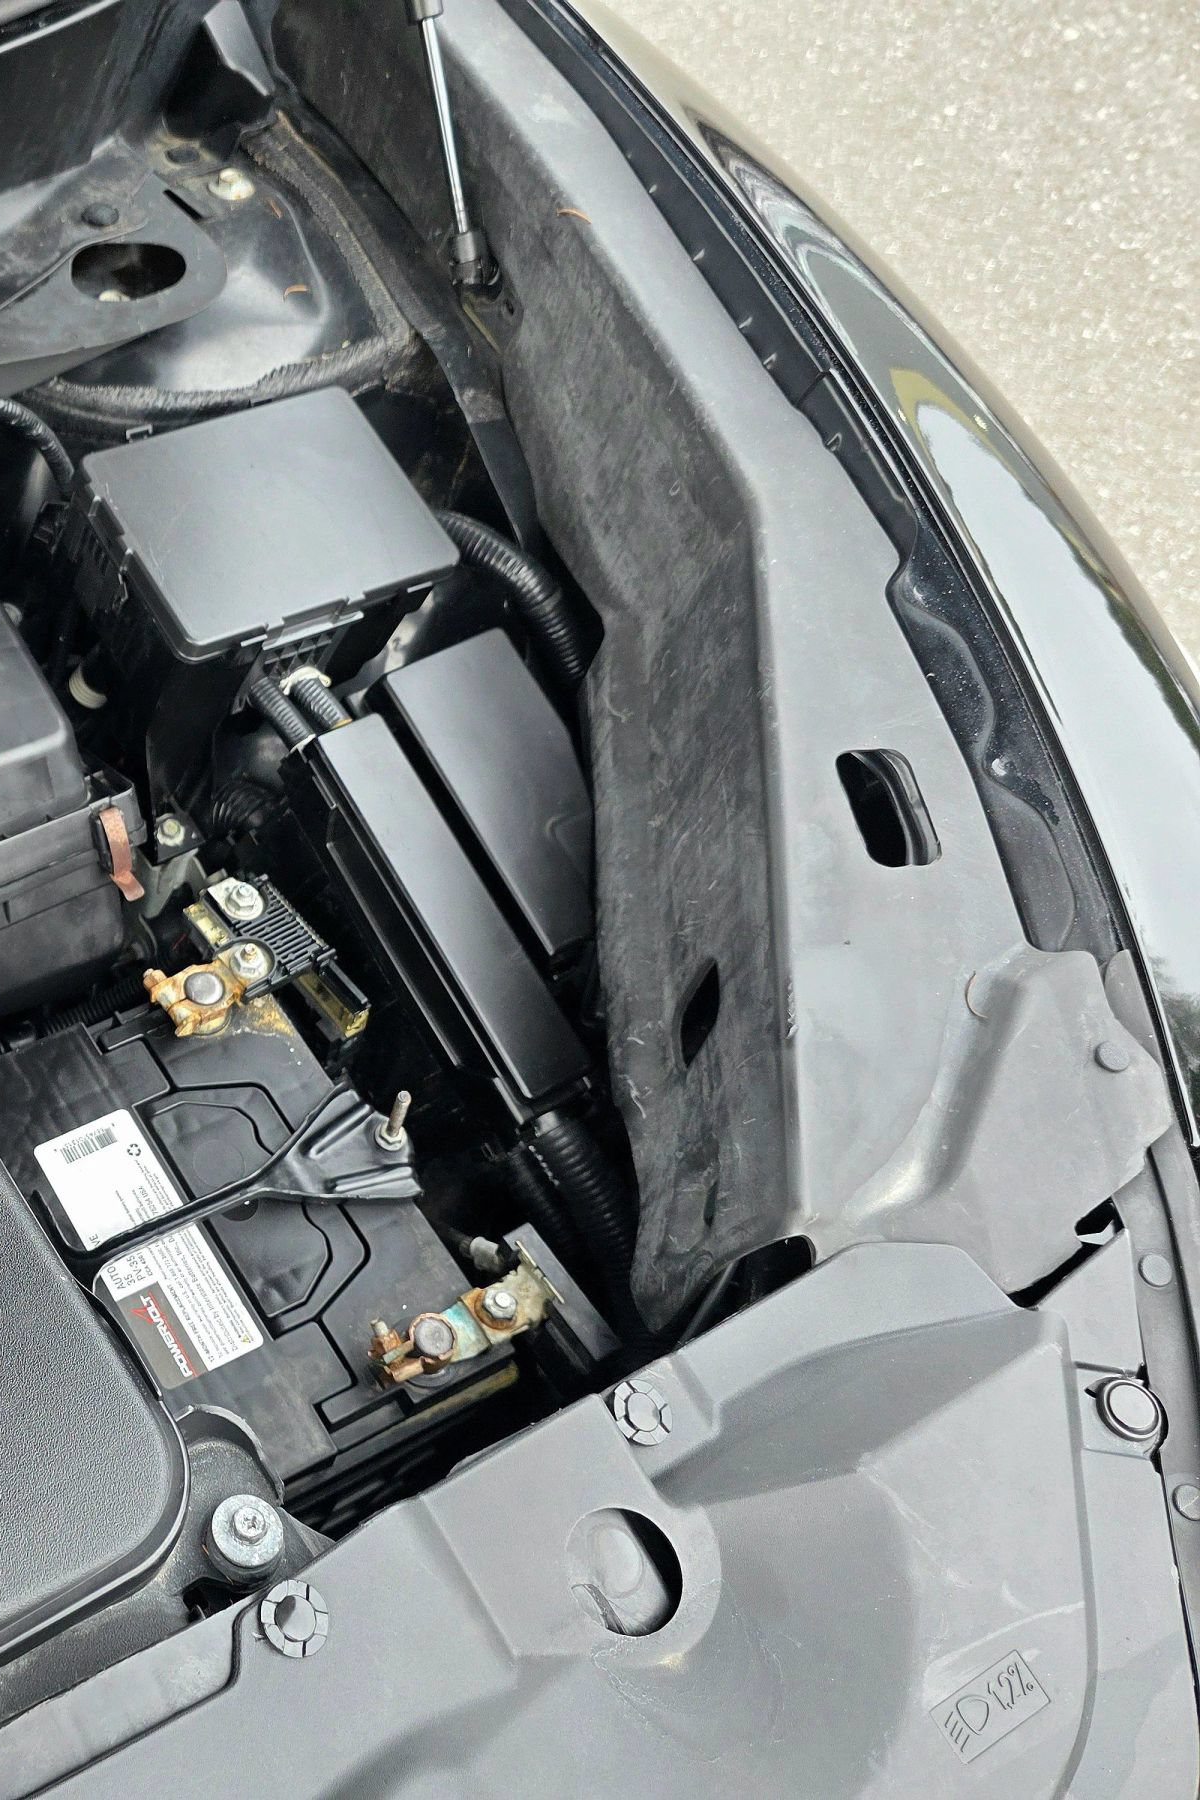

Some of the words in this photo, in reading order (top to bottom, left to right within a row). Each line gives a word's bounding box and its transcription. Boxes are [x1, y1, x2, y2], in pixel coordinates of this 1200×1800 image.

[123, 1273, 136, 1286] 35
[126, 1254, 146, 1282] PV-35
[138, 1292, 195, 1378] POWERVOLT
